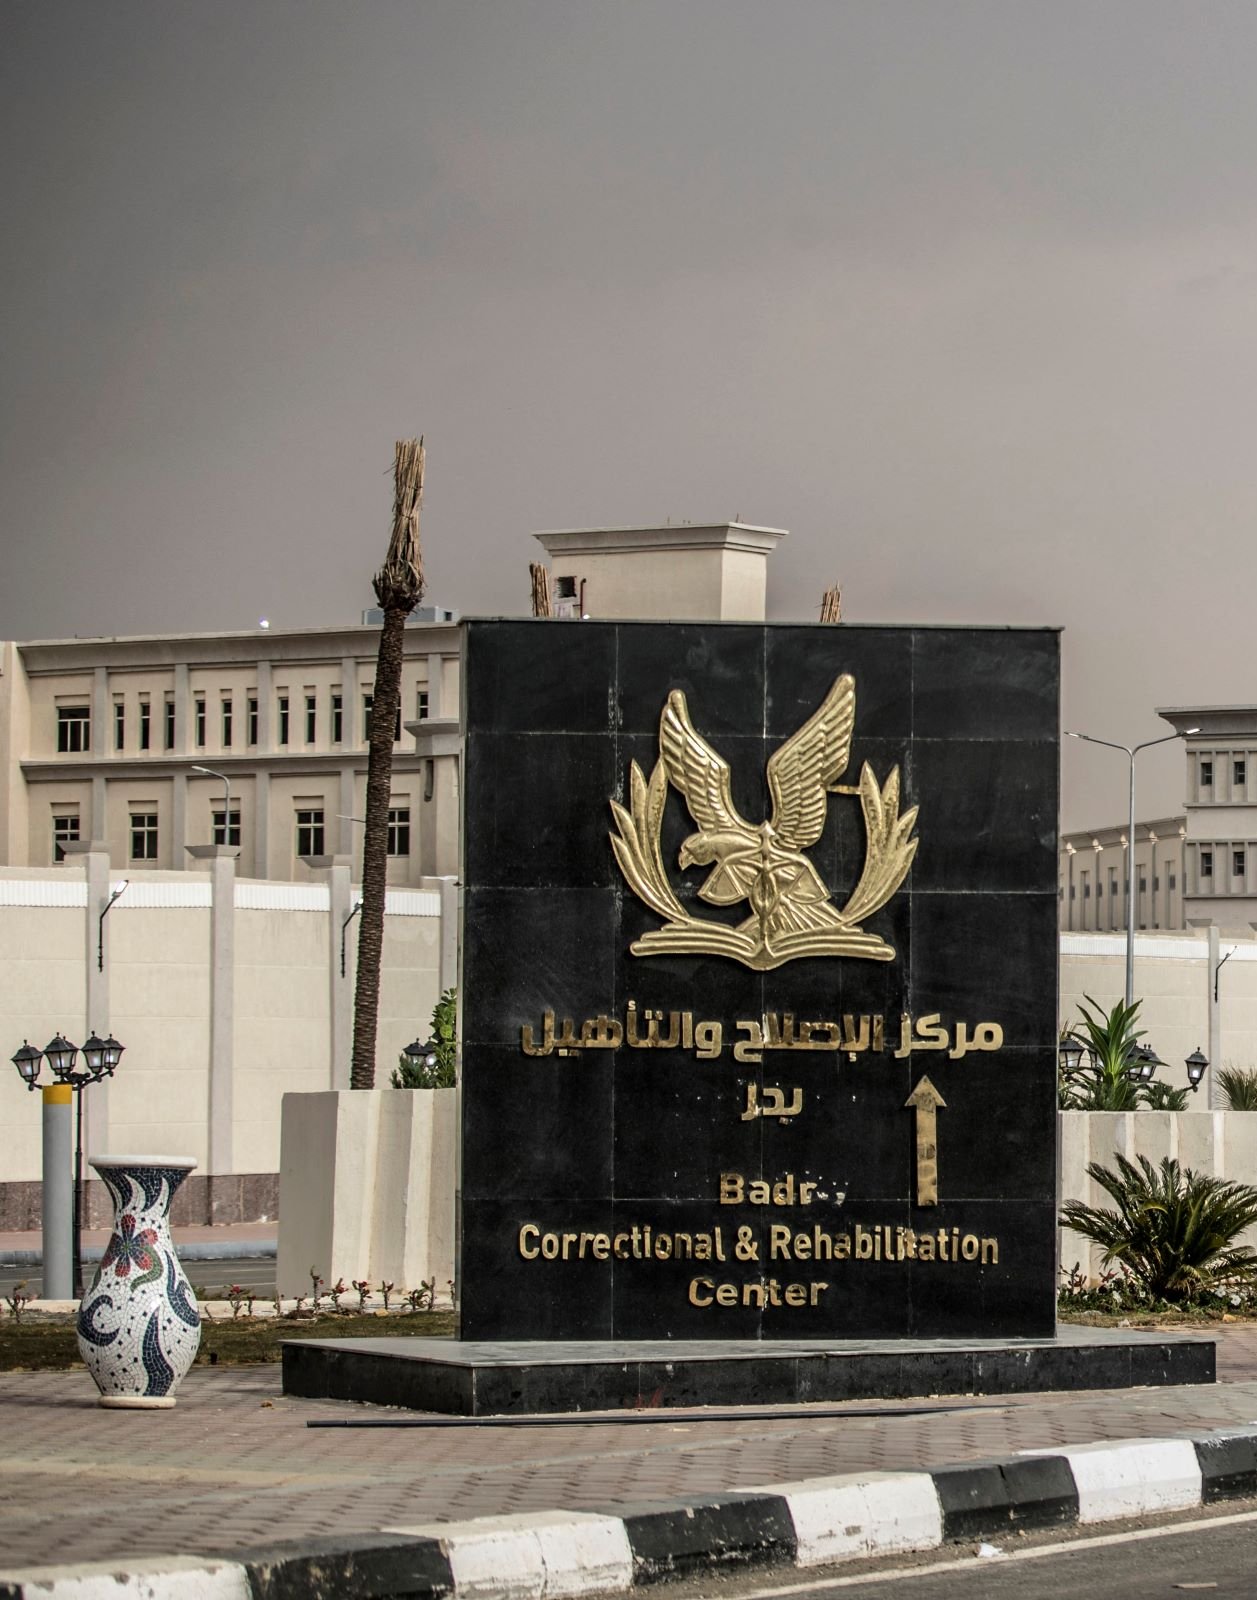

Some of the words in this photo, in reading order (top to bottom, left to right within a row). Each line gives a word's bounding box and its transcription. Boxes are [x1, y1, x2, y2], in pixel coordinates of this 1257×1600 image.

[522, 1000, 723, 1059] والتأهيل
[733, 1012, 884, 1063] الإصلاح
[894, 1012, 1004, 1059] مركز
[741, 1081, 803, 1125] بدر
[719, 1172, 817, 1205] Badr
[519, 1223, 726, 1262] Correctional
[735, 1225, 760, 1261] &
[770, 1224, 999, 1265] Rehabilitation
[689, 1276, 829, 1307] Center
